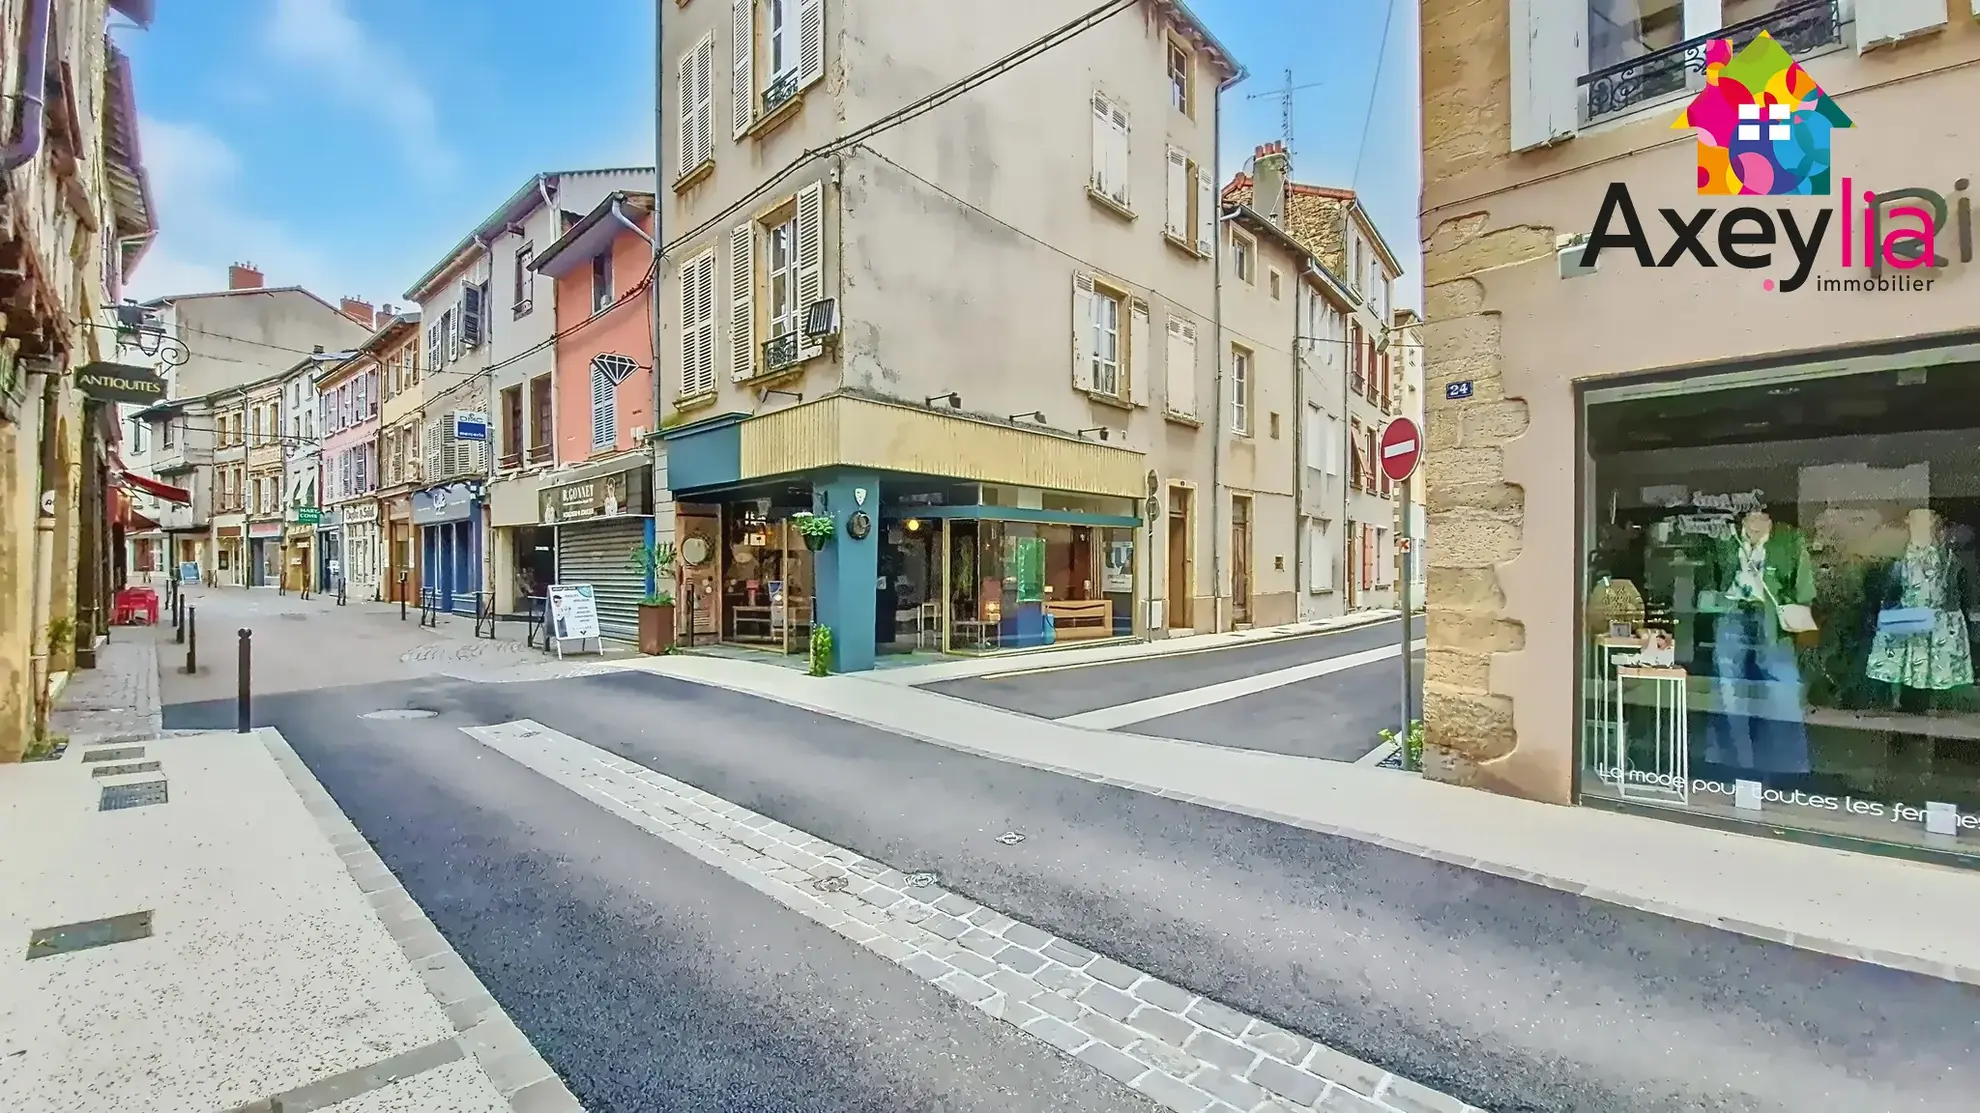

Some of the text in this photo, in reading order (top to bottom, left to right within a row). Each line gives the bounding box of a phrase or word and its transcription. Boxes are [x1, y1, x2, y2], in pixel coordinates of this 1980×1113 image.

[80, 374, 161, 393] ANTIQUITES
[1450, 383, 1469, 396] 24
[1600, 762, 1624, 781] La
[1629, 769, 1686, 788] mode
[1692, 779, 1745, 795] pou
[1846, 795, 1884, 816] les
